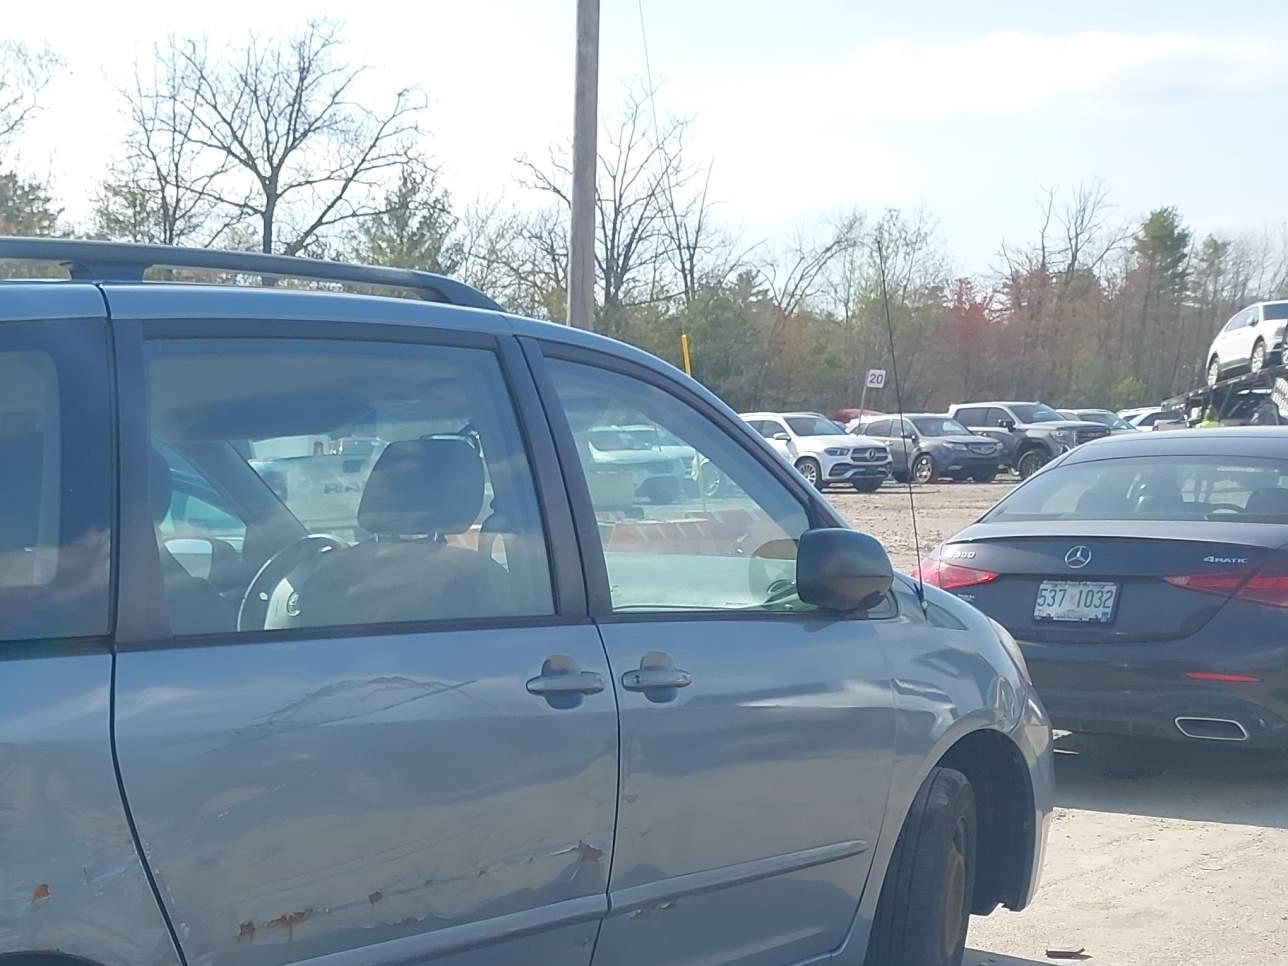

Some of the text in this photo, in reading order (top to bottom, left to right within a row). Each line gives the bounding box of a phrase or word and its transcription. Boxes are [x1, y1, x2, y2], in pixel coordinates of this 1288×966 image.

[869, 373, 883, 385] 20
[1203, 555, 1249, 564] 4MATIC
[1037, 588, 1114, 609] 537 1032
